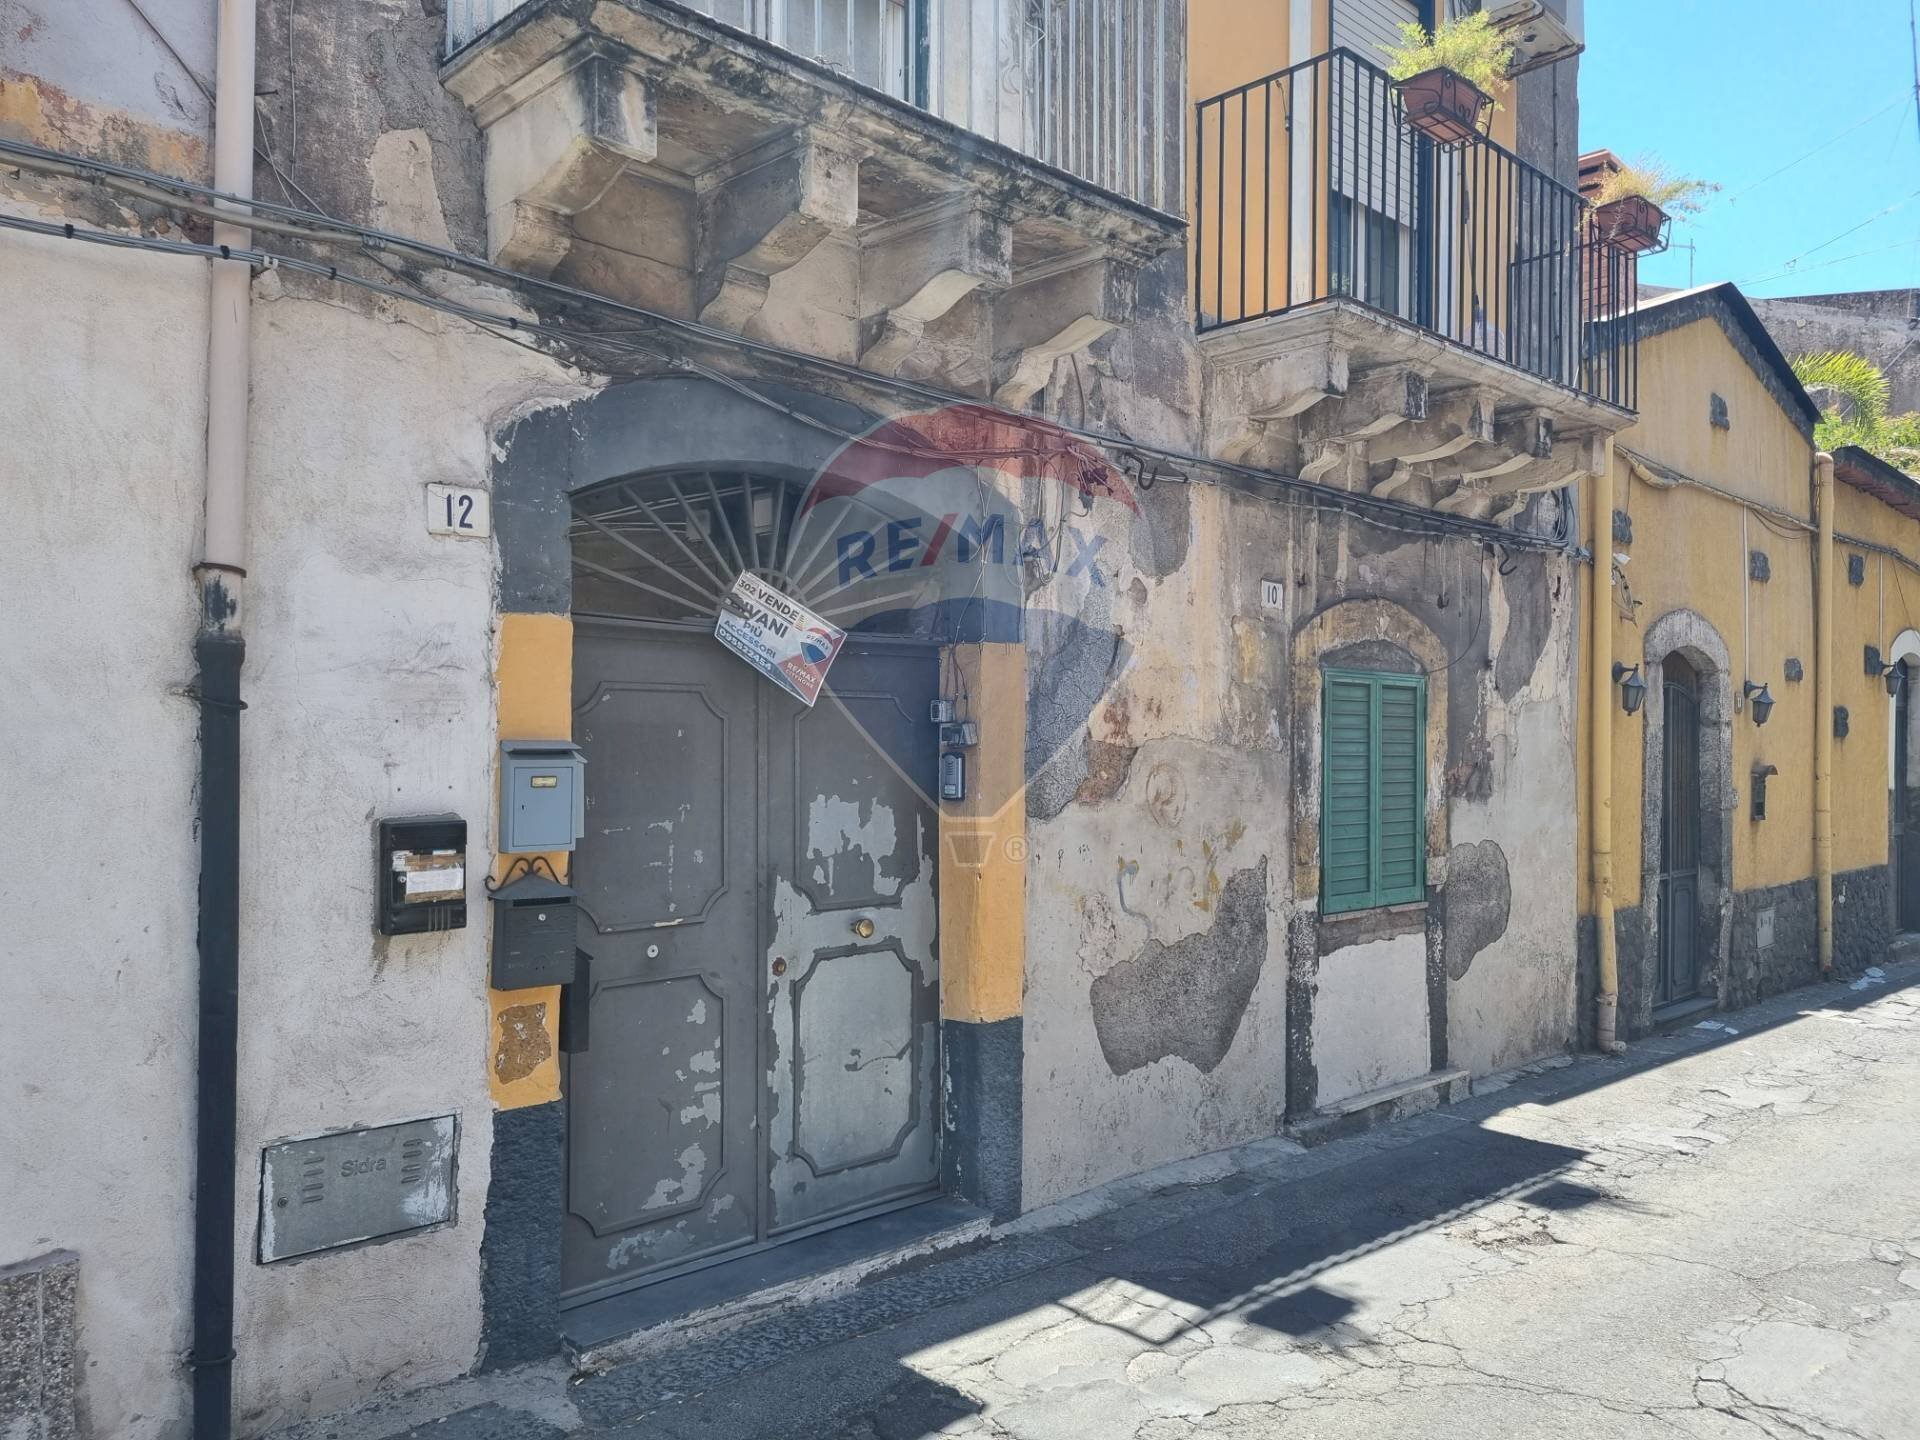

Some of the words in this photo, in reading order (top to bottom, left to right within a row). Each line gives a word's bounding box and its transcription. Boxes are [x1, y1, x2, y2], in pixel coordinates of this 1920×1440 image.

[446, 494, 473, 528] 12
[756, 589, 800, 621] VENDE
[1267, 585, 1278, 605] 10
[724, 619, 777, 659] ACCESSORI
[786, 662, 817, 683] RE/MAX
[340, 1157, 387, 1178] Sidra
